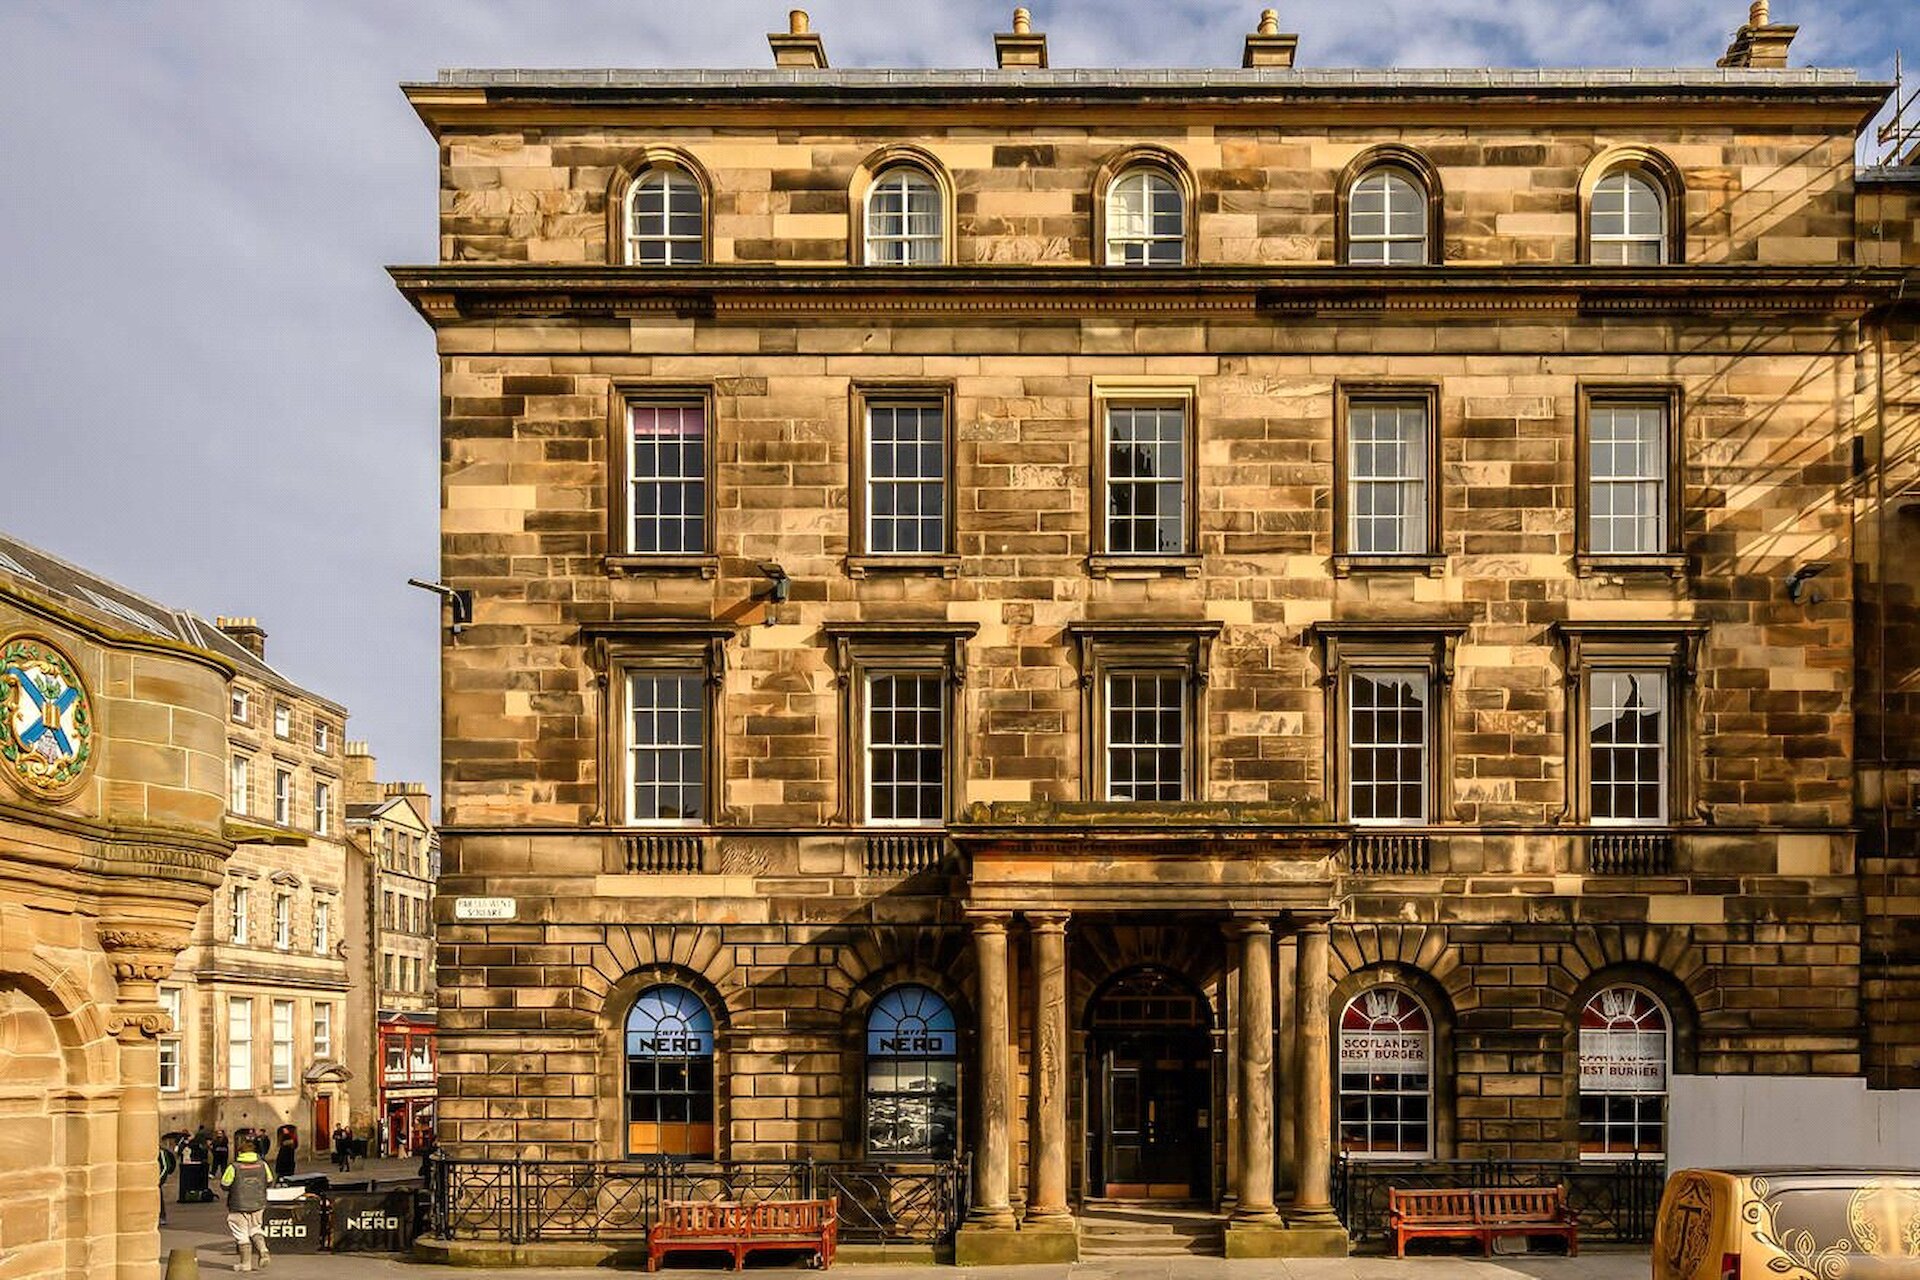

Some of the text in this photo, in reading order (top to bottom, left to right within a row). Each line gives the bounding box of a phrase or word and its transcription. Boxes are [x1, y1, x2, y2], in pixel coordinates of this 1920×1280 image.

[640, 1038, 701, 1051] NERO
[880, 1038, 943, 1051] NERO
[1344, 1039, 1421, 1048] SCOTLAND'S
[1341, 1049, 1424, 1060] BEST BURGER
[347, 1217, 399, 1230] NERO
